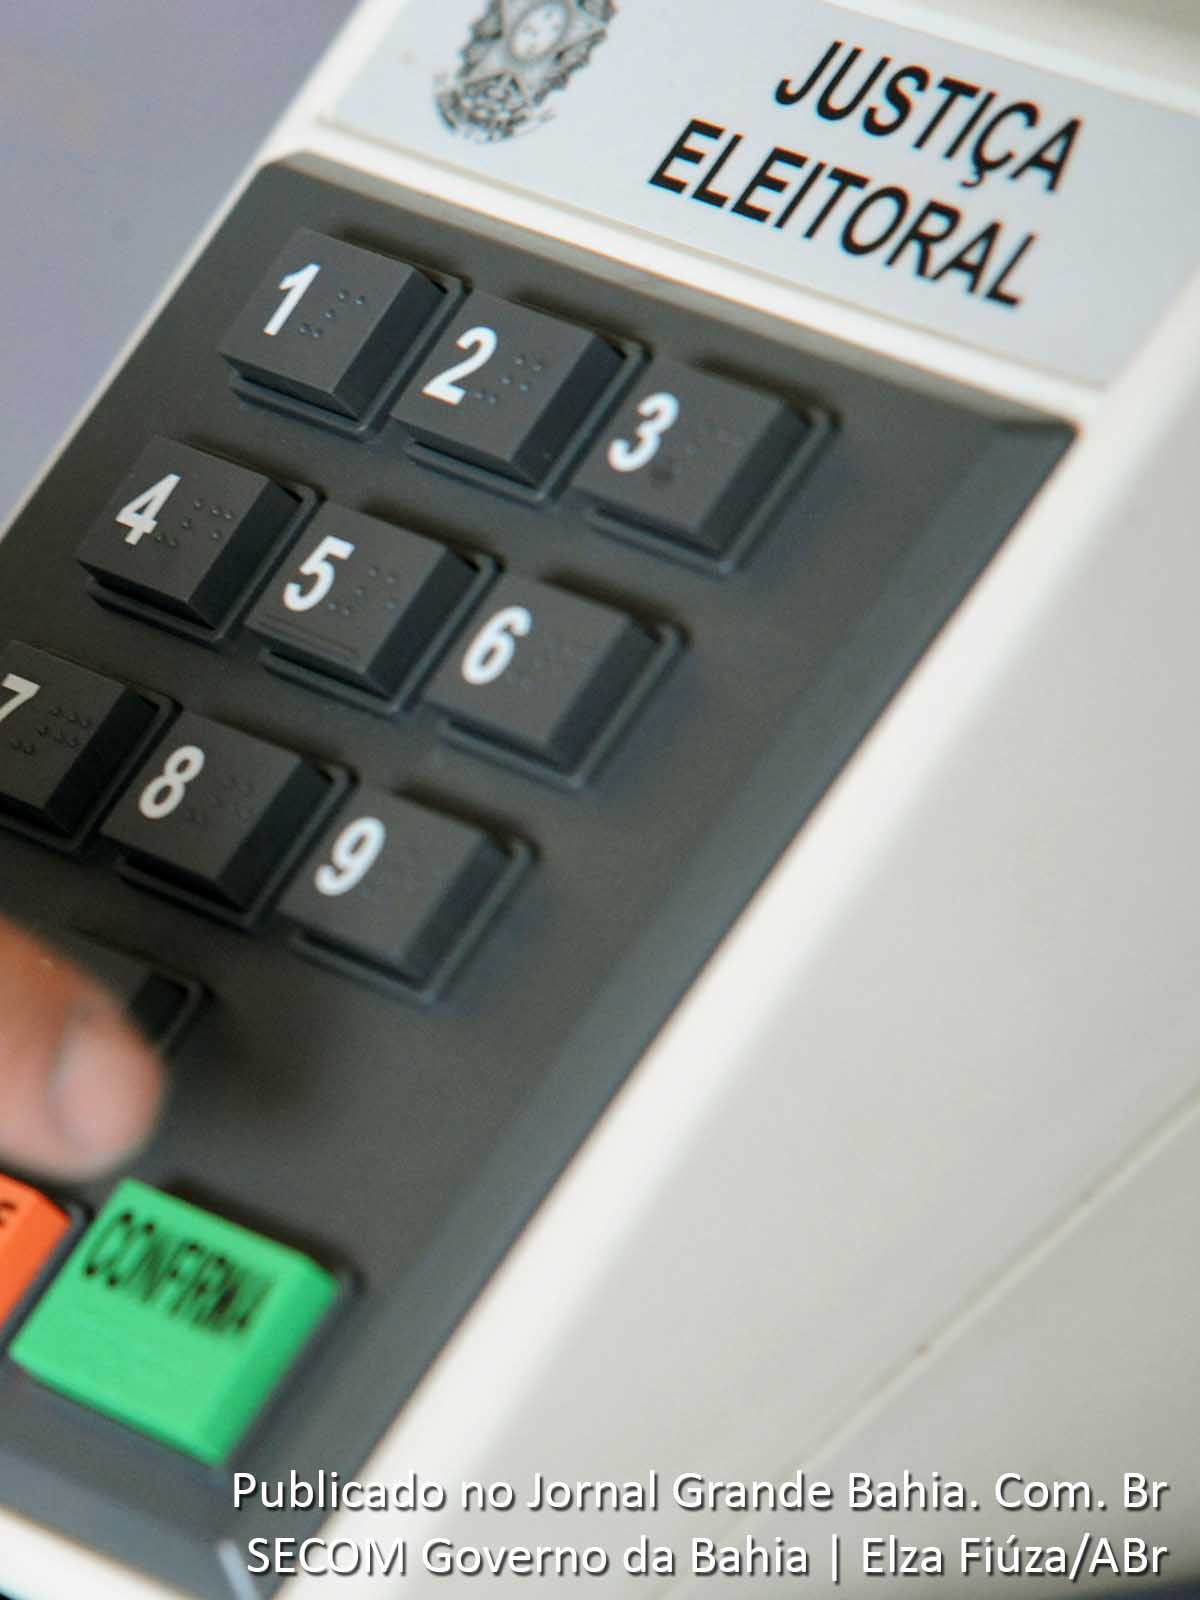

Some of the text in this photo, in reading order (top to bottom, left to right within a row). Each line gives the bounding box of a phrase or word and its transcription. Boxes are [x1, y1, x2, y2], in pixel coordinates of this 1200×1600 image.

[774, 40, 1082, 193] JUSTIÇA
[647, 118, 1035, 308] ELEITORAL
[262, 262, 320, 337] 1
[421, 325, 498, 406] 2
[607, 392, 680, 473] 3
[115, 473, 181, 546] 4
[282, 534, 356, 612] 5
[460, 605, 532, 686] 6
[140, 745, 205, 819] 8
[315, 816, 386, 896] 9
[83, 1208, 278, 1336] CONFIRMA
